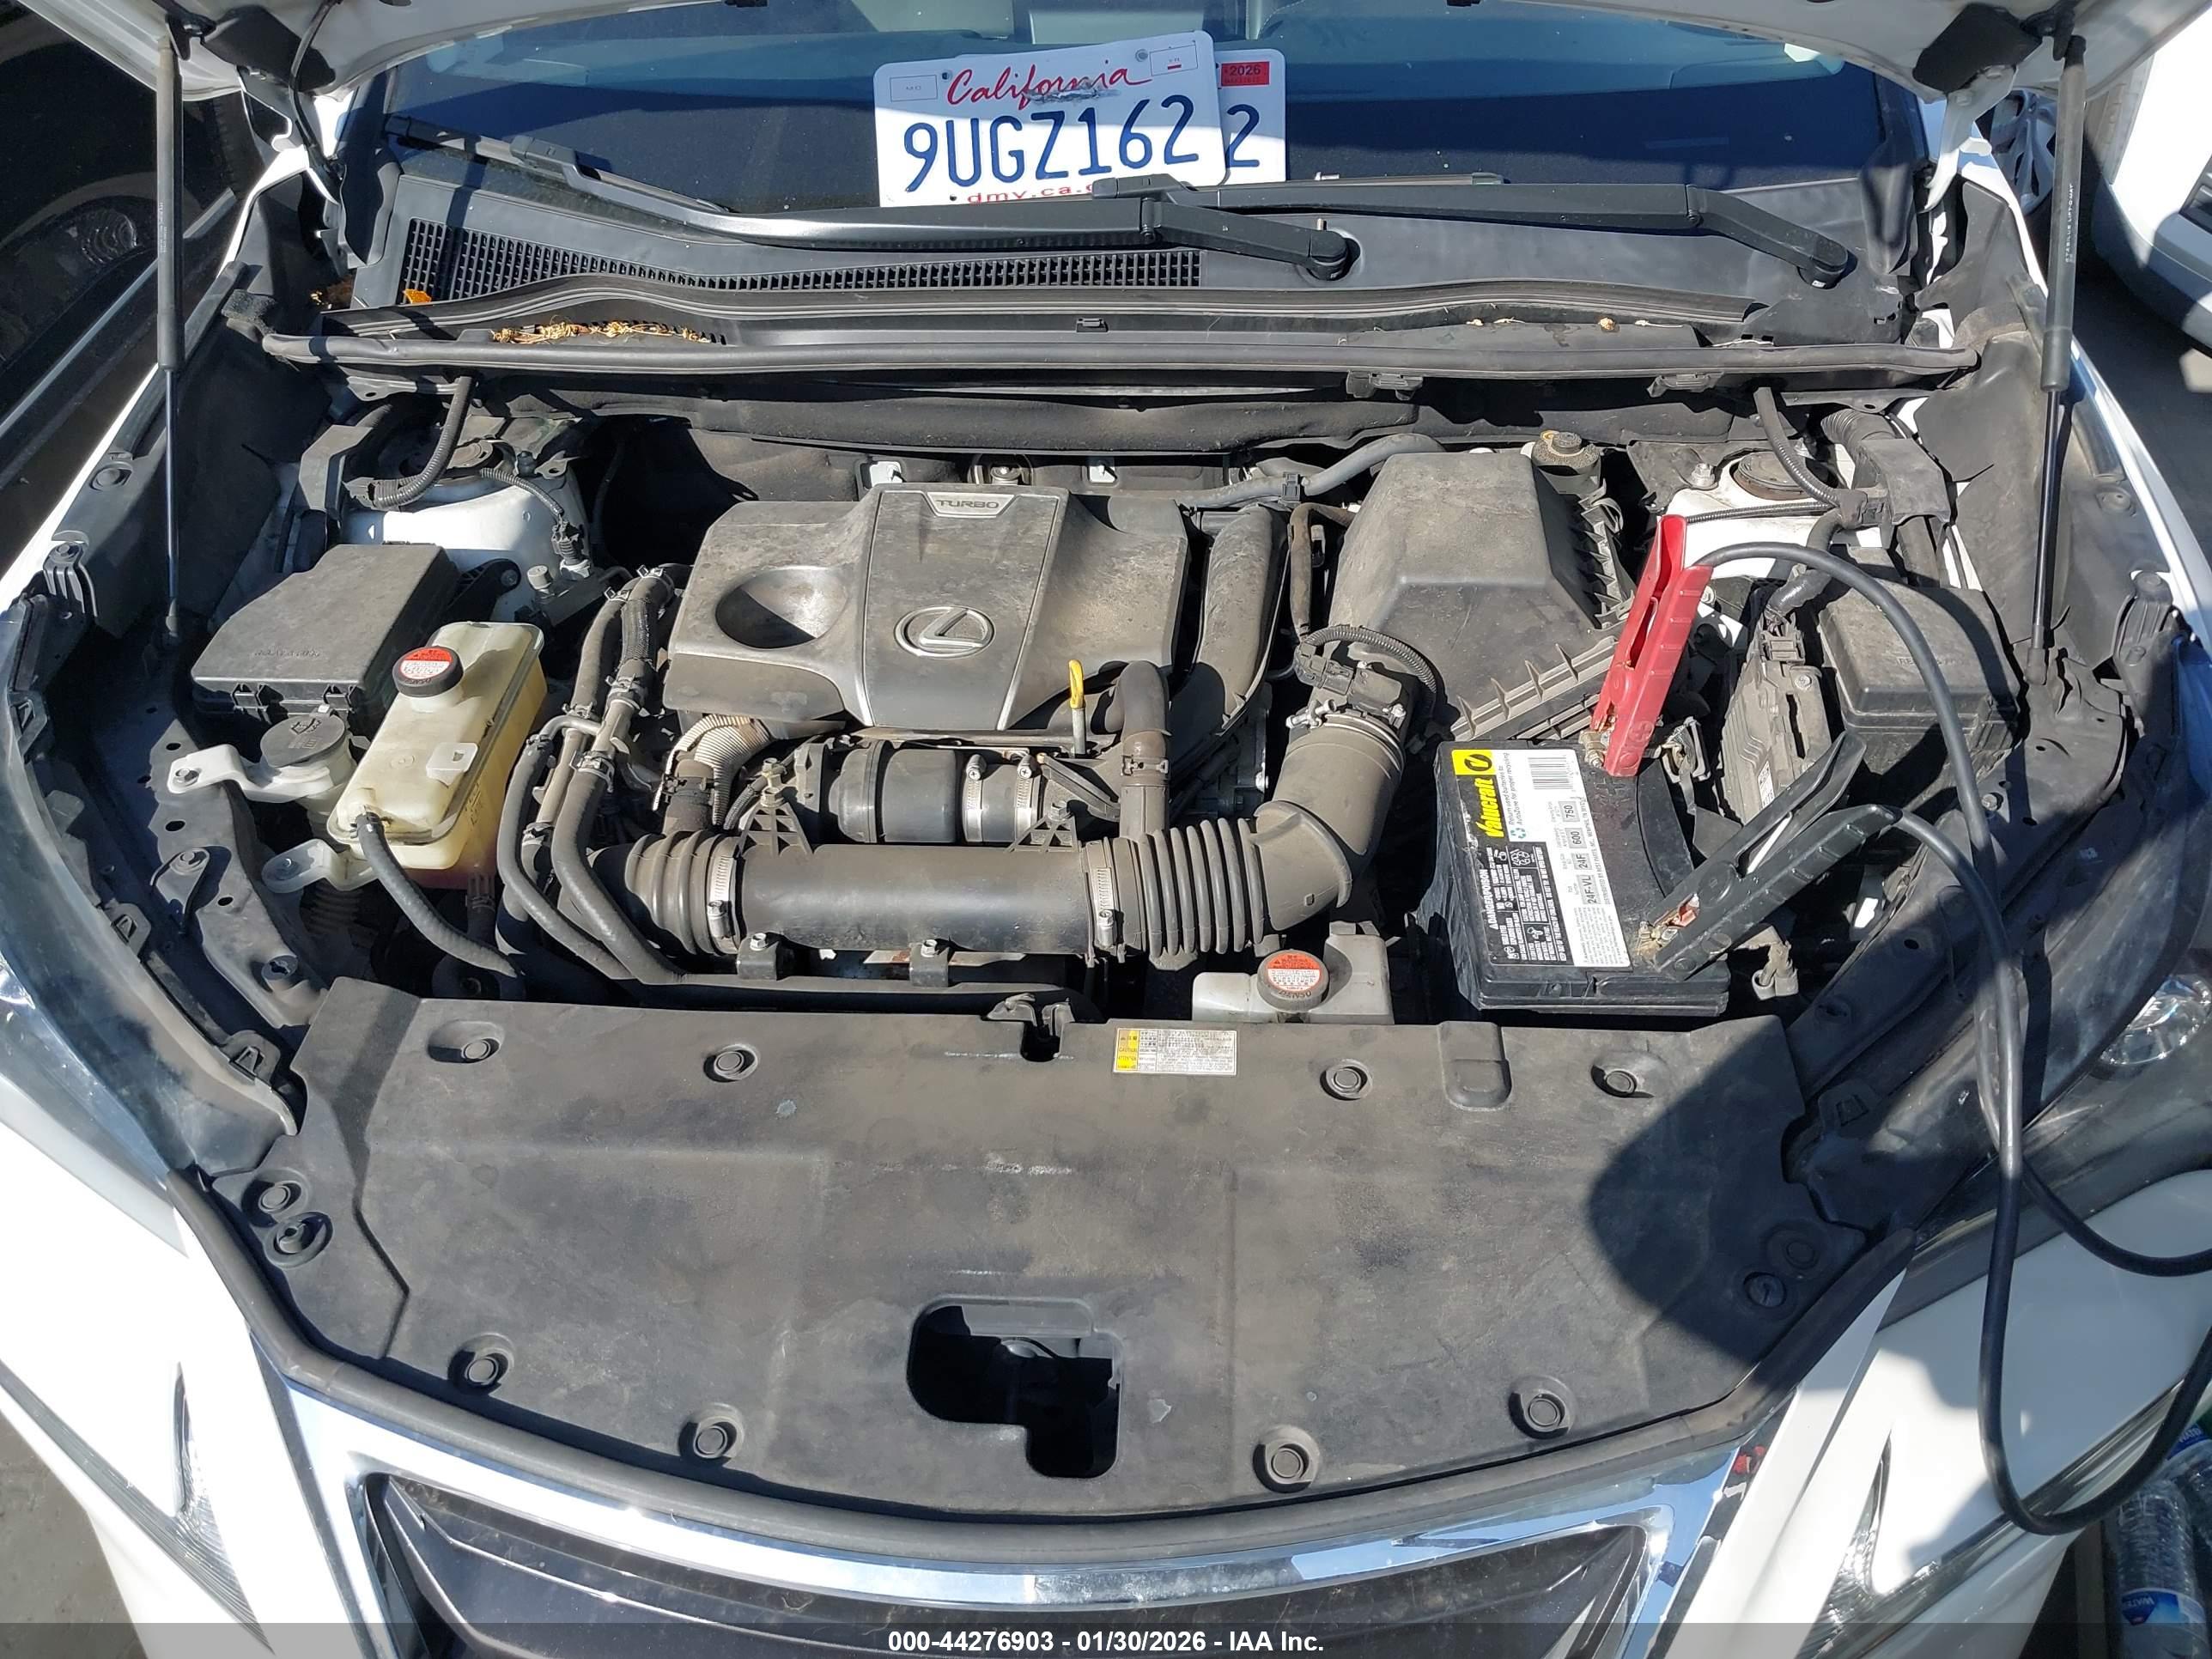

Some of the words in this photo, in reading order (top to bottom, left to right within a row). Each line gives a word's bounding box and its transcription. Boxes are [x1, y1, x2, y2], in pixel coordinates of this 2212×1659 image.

[1230, 64, 1261, 76] 2026
[947, 59, 1152, 111] California
[1225, 104, 1260, 167] 2
[903, 94, 1199, 192] 9UGZ162
[936, 499, 1000, 508] TURBO
[1563, 805, 1575, 817] 750
[1570, 830, 1582, 844] 600
[1575, 854, 1588, 867] 24F
[1580, 875, 1597, 903] 24F-VL
